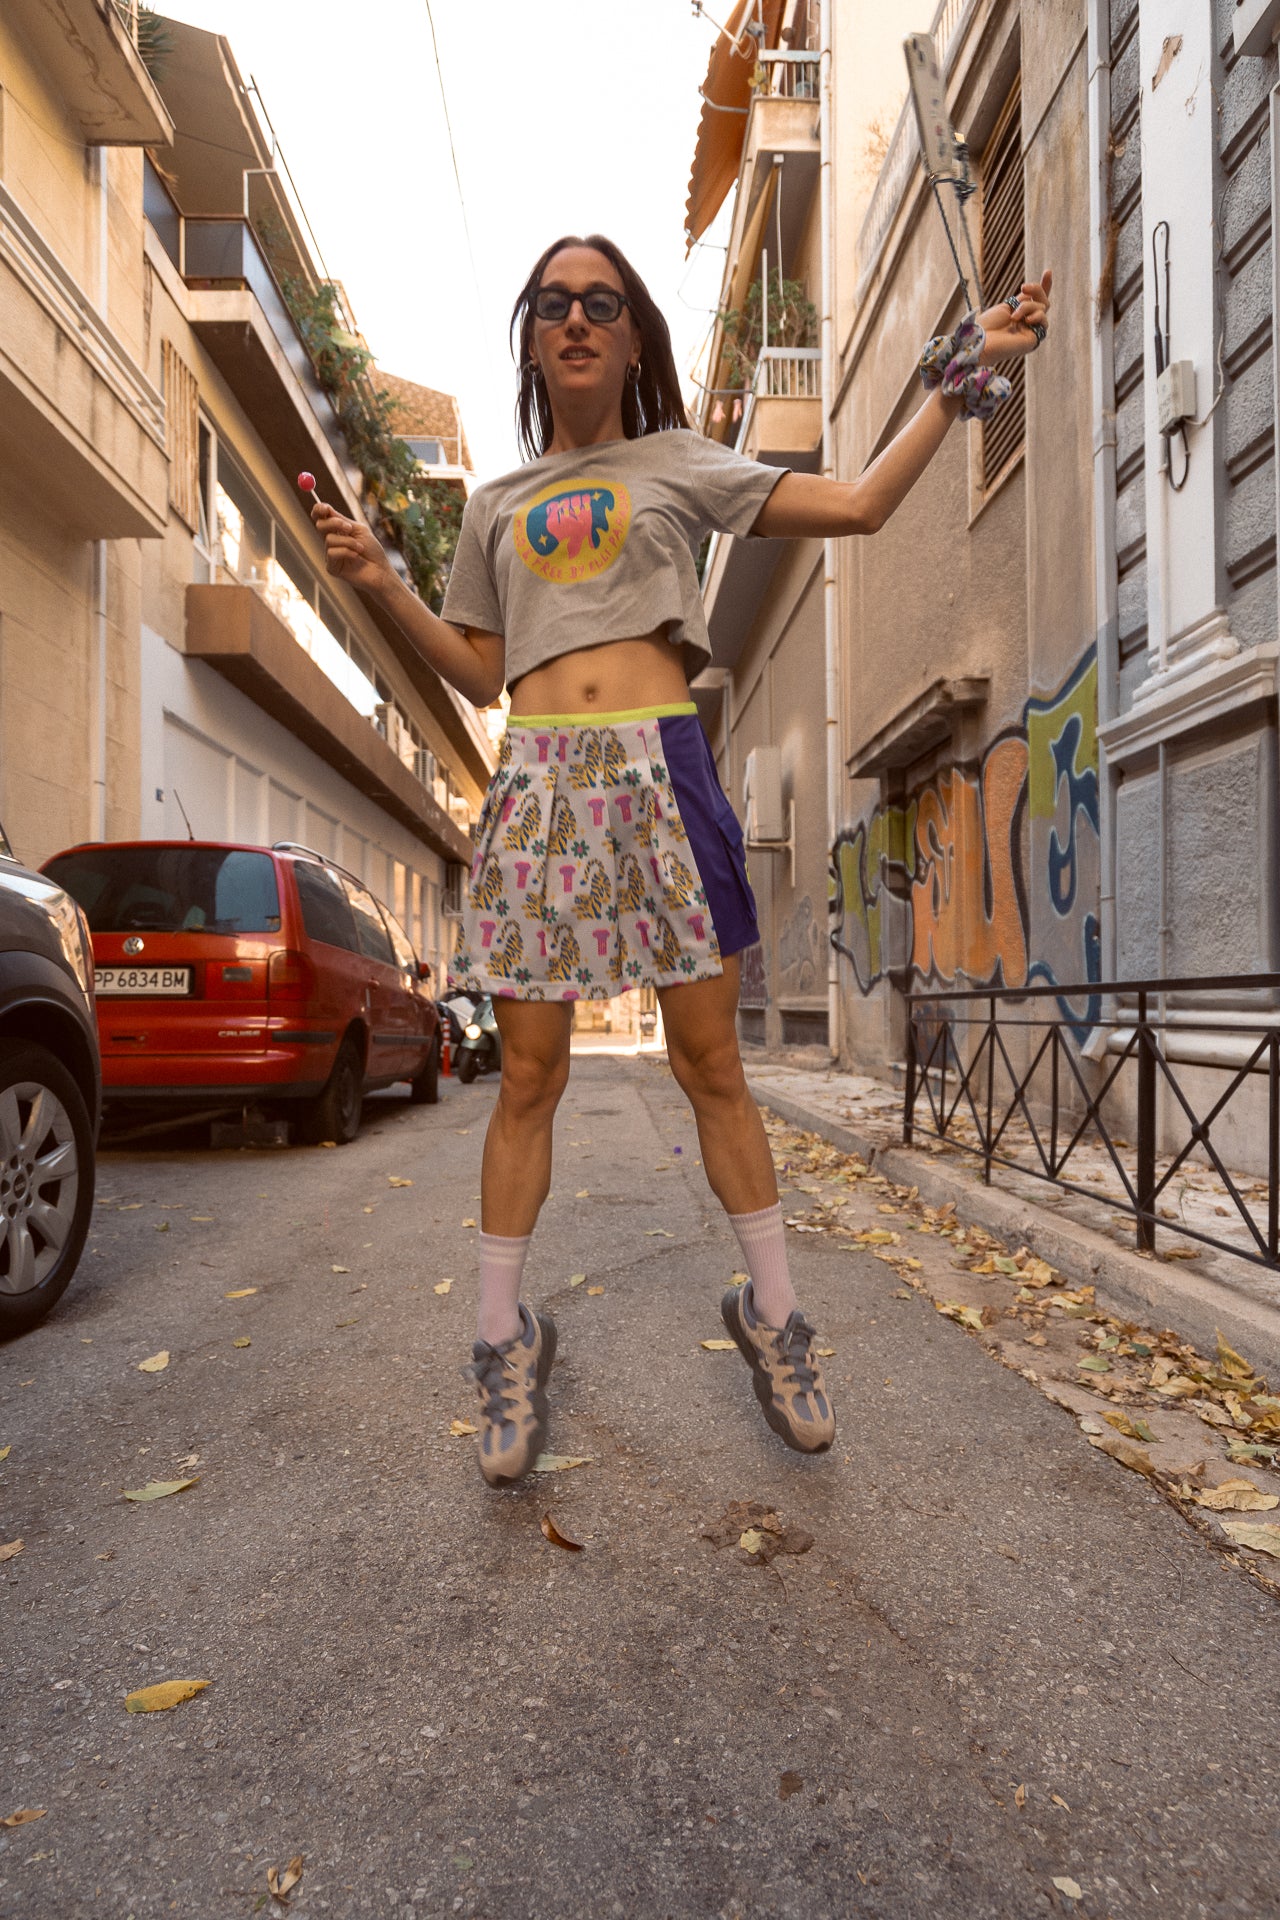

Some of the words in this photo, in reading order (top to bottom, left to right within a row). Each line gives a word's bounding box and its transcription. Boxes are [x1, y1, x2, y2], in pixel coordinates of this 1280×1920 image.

[531, 558, 562, 579] FREE
[569, 565, 585, 579] BY
[117, 972, 158, 988] 6834
[162, 971, 185, 988] BM
